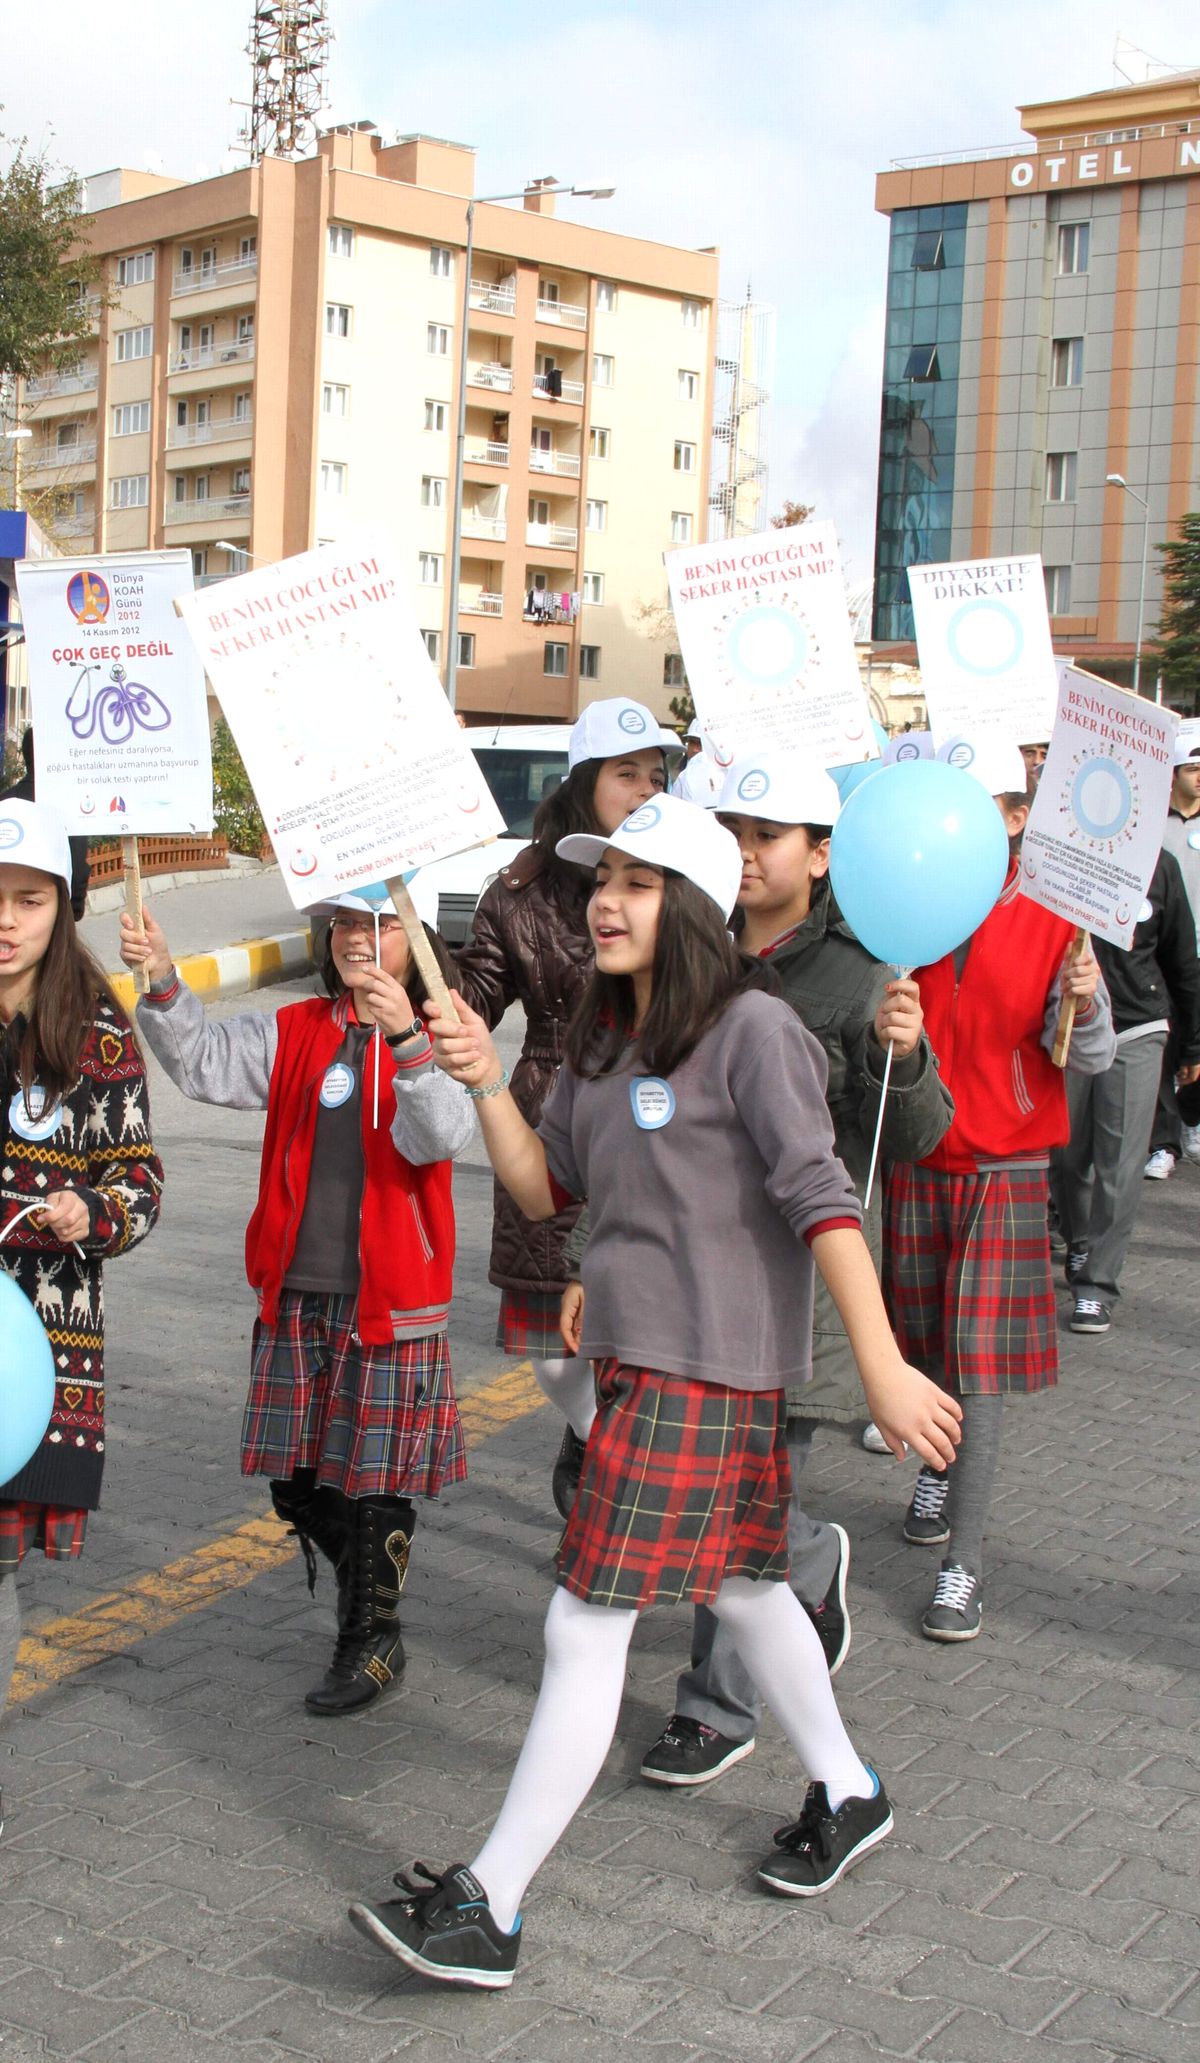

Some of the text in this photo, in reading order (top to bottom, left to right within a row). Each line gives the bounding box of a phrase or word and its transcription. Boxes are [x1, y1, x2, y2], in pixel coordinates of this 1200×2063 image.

[1011, 151, 1132, 187] OTEL
[685, 541, 824, 581] BENİM ÇOCUĞUM
[113, 574, 143, 583] Dünya
[680, 560, 835, 603] ŞEKER HASTASI MI?
[115, 586, 143, 595] KOAH
[208, 558, 380, 632] BENİM ÇOCUĞUM
[935, 578, 1023, 599] DİKKAT!
[116, 599, 142, 608] Günü
[277, 594, 357, 636] HASTASI
[362, 580, 396, 602] MI?
[118, 612, 140, 620] 2012
[94, 628, 118, 636] Kasım
[121, 627, 140, 635] 2012
[53, 640, 173, 665] ÇOK GEÇ DEĞİL
[1069, 691, 1105, 715] BENİM
[1108, 708, 1165, 743] ÇOCUĞUM
[1061, 707, 1169, 764] ŞEKER HASTASI MI?
[69, 748, 87, 758] Eğer
[89, 747, 124, 755] nefesiniz
[118, 760, 158, 768] uzmanına
[161, 759, 199, 768] başvurup
[91, 775, 112, 784] soluk
[350, 840, 374, 856] YAKIN
